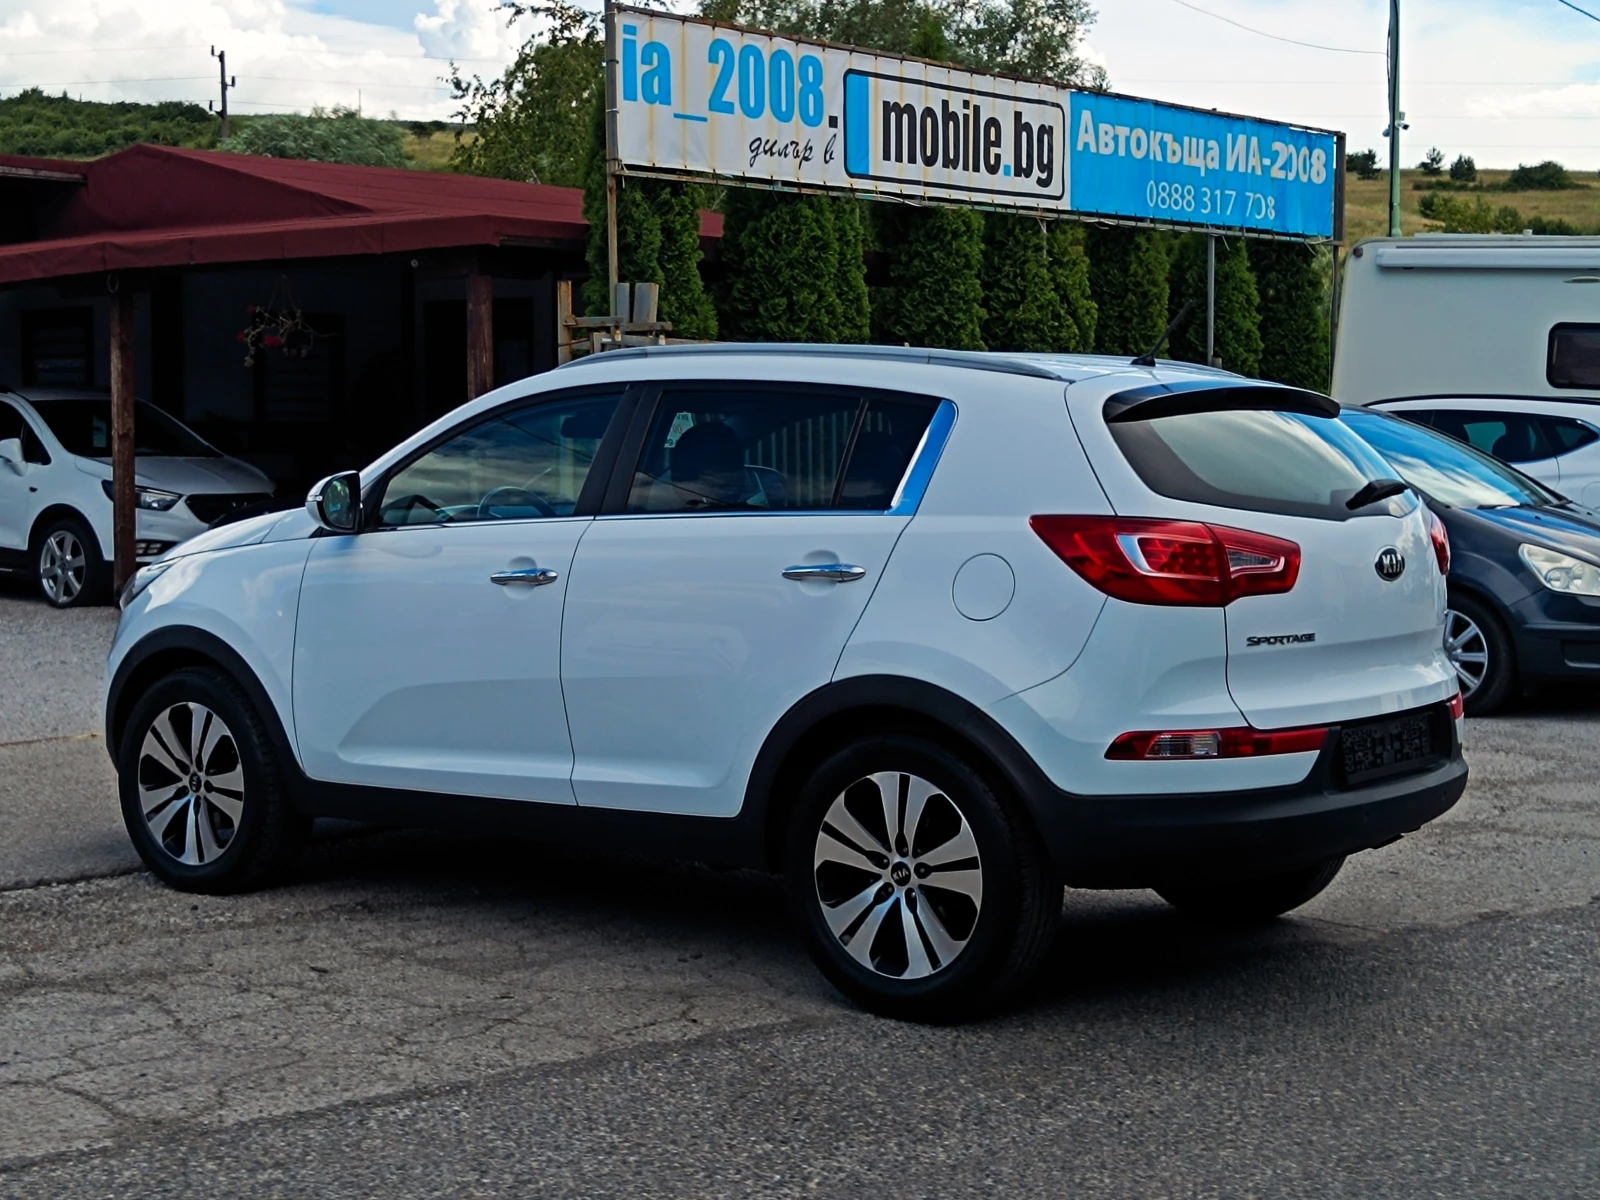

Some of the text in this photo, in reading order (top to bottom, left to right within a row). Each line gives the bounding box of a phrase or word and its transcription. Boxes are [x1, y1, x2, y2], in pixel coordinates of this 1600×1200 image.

[883, 99, 1054, 188] mobile.bg
[1076, 109, 1326, 184] Автокъща ИА-2008
[1146, 180, 1195, 212] 0888
[1201, 187, 1236, 216] 317
[1381, 553, 1404, 574] KIA
[1246, 632, 1316, 647] SPORTAGE
